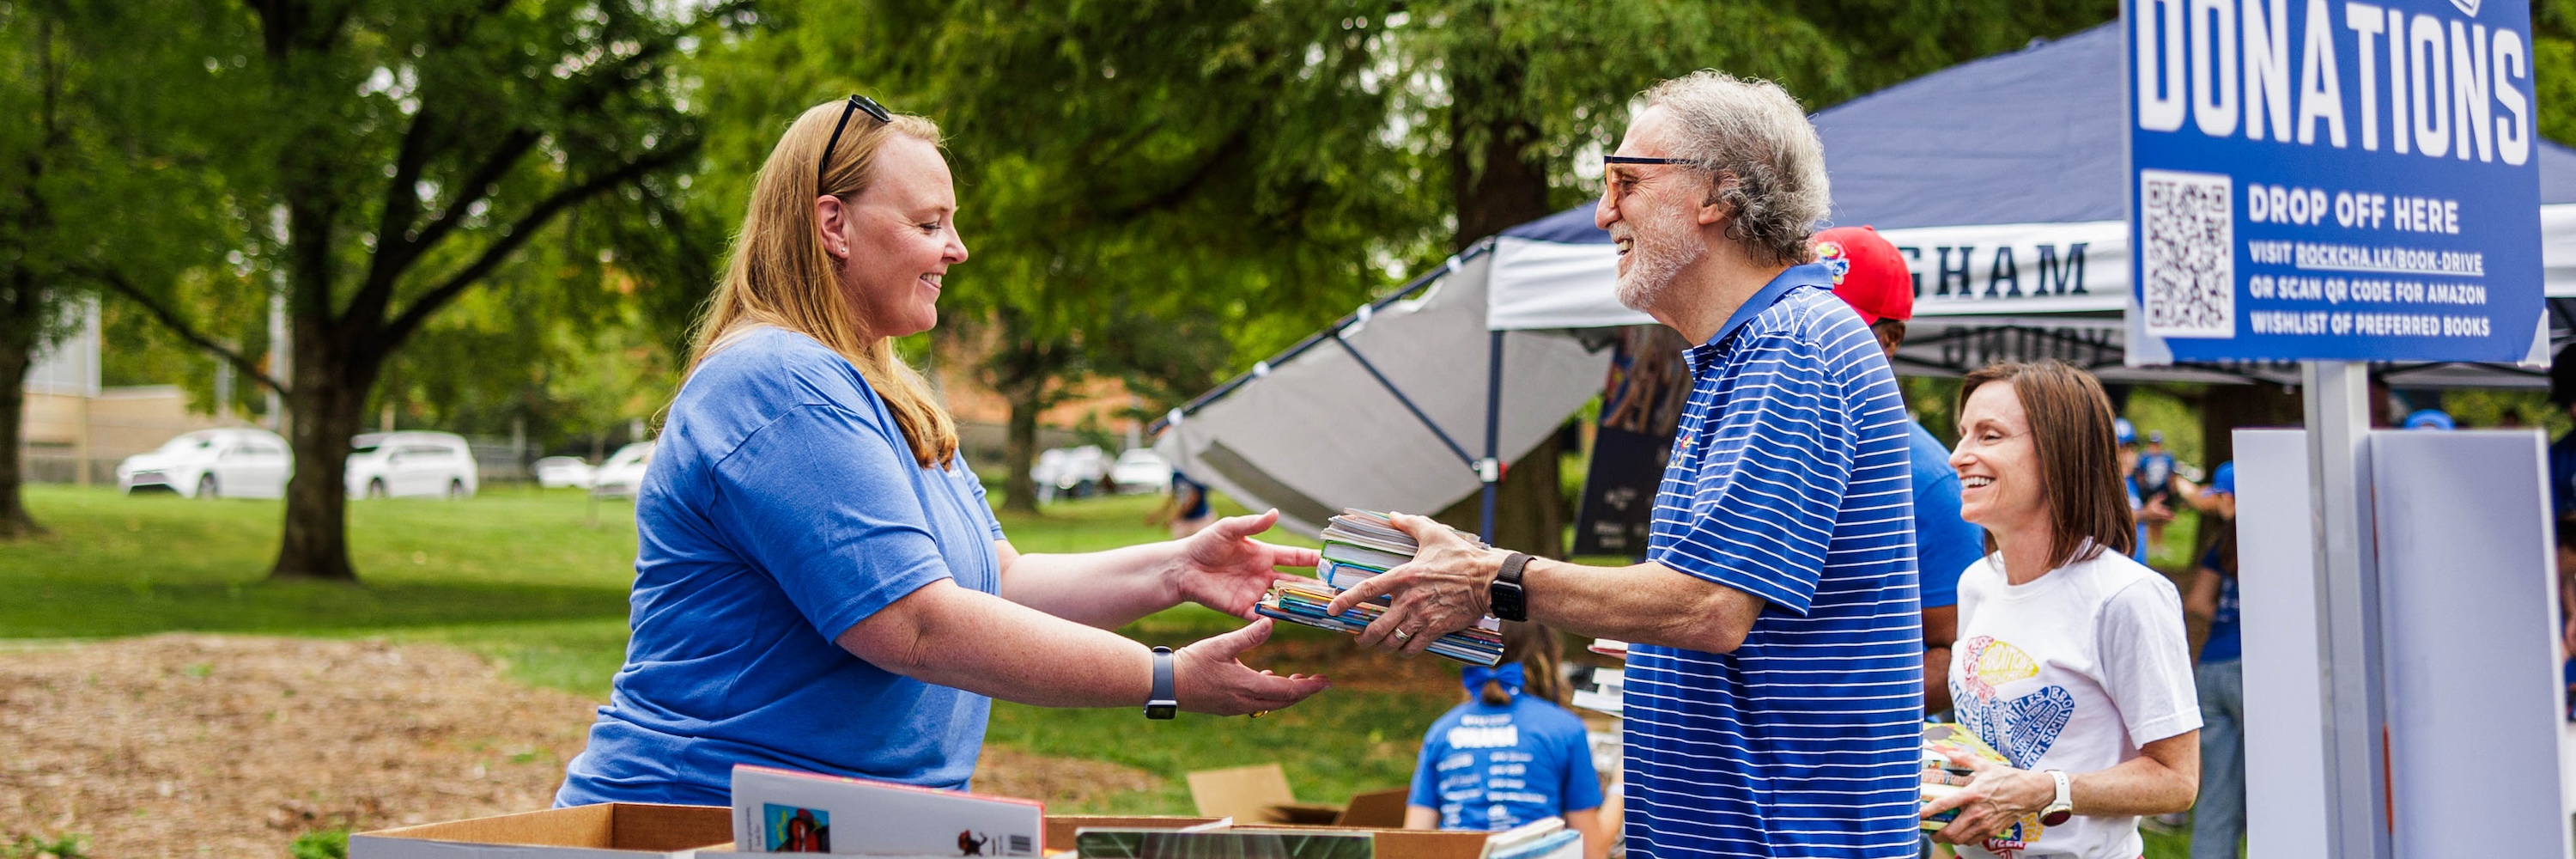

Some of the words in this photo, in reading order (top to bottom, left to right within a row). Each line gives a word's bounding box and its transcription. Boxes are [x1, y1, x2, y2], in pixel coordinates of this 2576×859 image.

[2135, 0, 2530, 166] DONATIONS
[2248, 184, 2328, 225] DROP
[2335, 192, 2385, 229] OFF
[2393, 197, 2460, 235] HERE
[2248, 241, 2292, 264] VISIT
[2295, 242, 2483, 274] ROCKCHA.LK/BOOK-DRIVE
[2249, 275, 2275, 299] OR
[2278, 277, 2322, 300] SCAN
[2324, 277, 2348, 304] QR
[2350, 280, 2391, 302] CODE
[2395, 282, 2424, 303] FOR
[2427, 283, 2486, 305] AMAZON
[2250, 310, 2328, 335] WISHLIST
[2330, 313, 2352, 336] OF
[2355, 314, 2439, 337] PREFERRED
[2443, 317, 2490, 338] BOOKS
[2005, 691, 2044, 735] RAFFLES
[2023, 745, 2048, 770] REAM
[2041, 710, 2071, 745] SOCIAL
